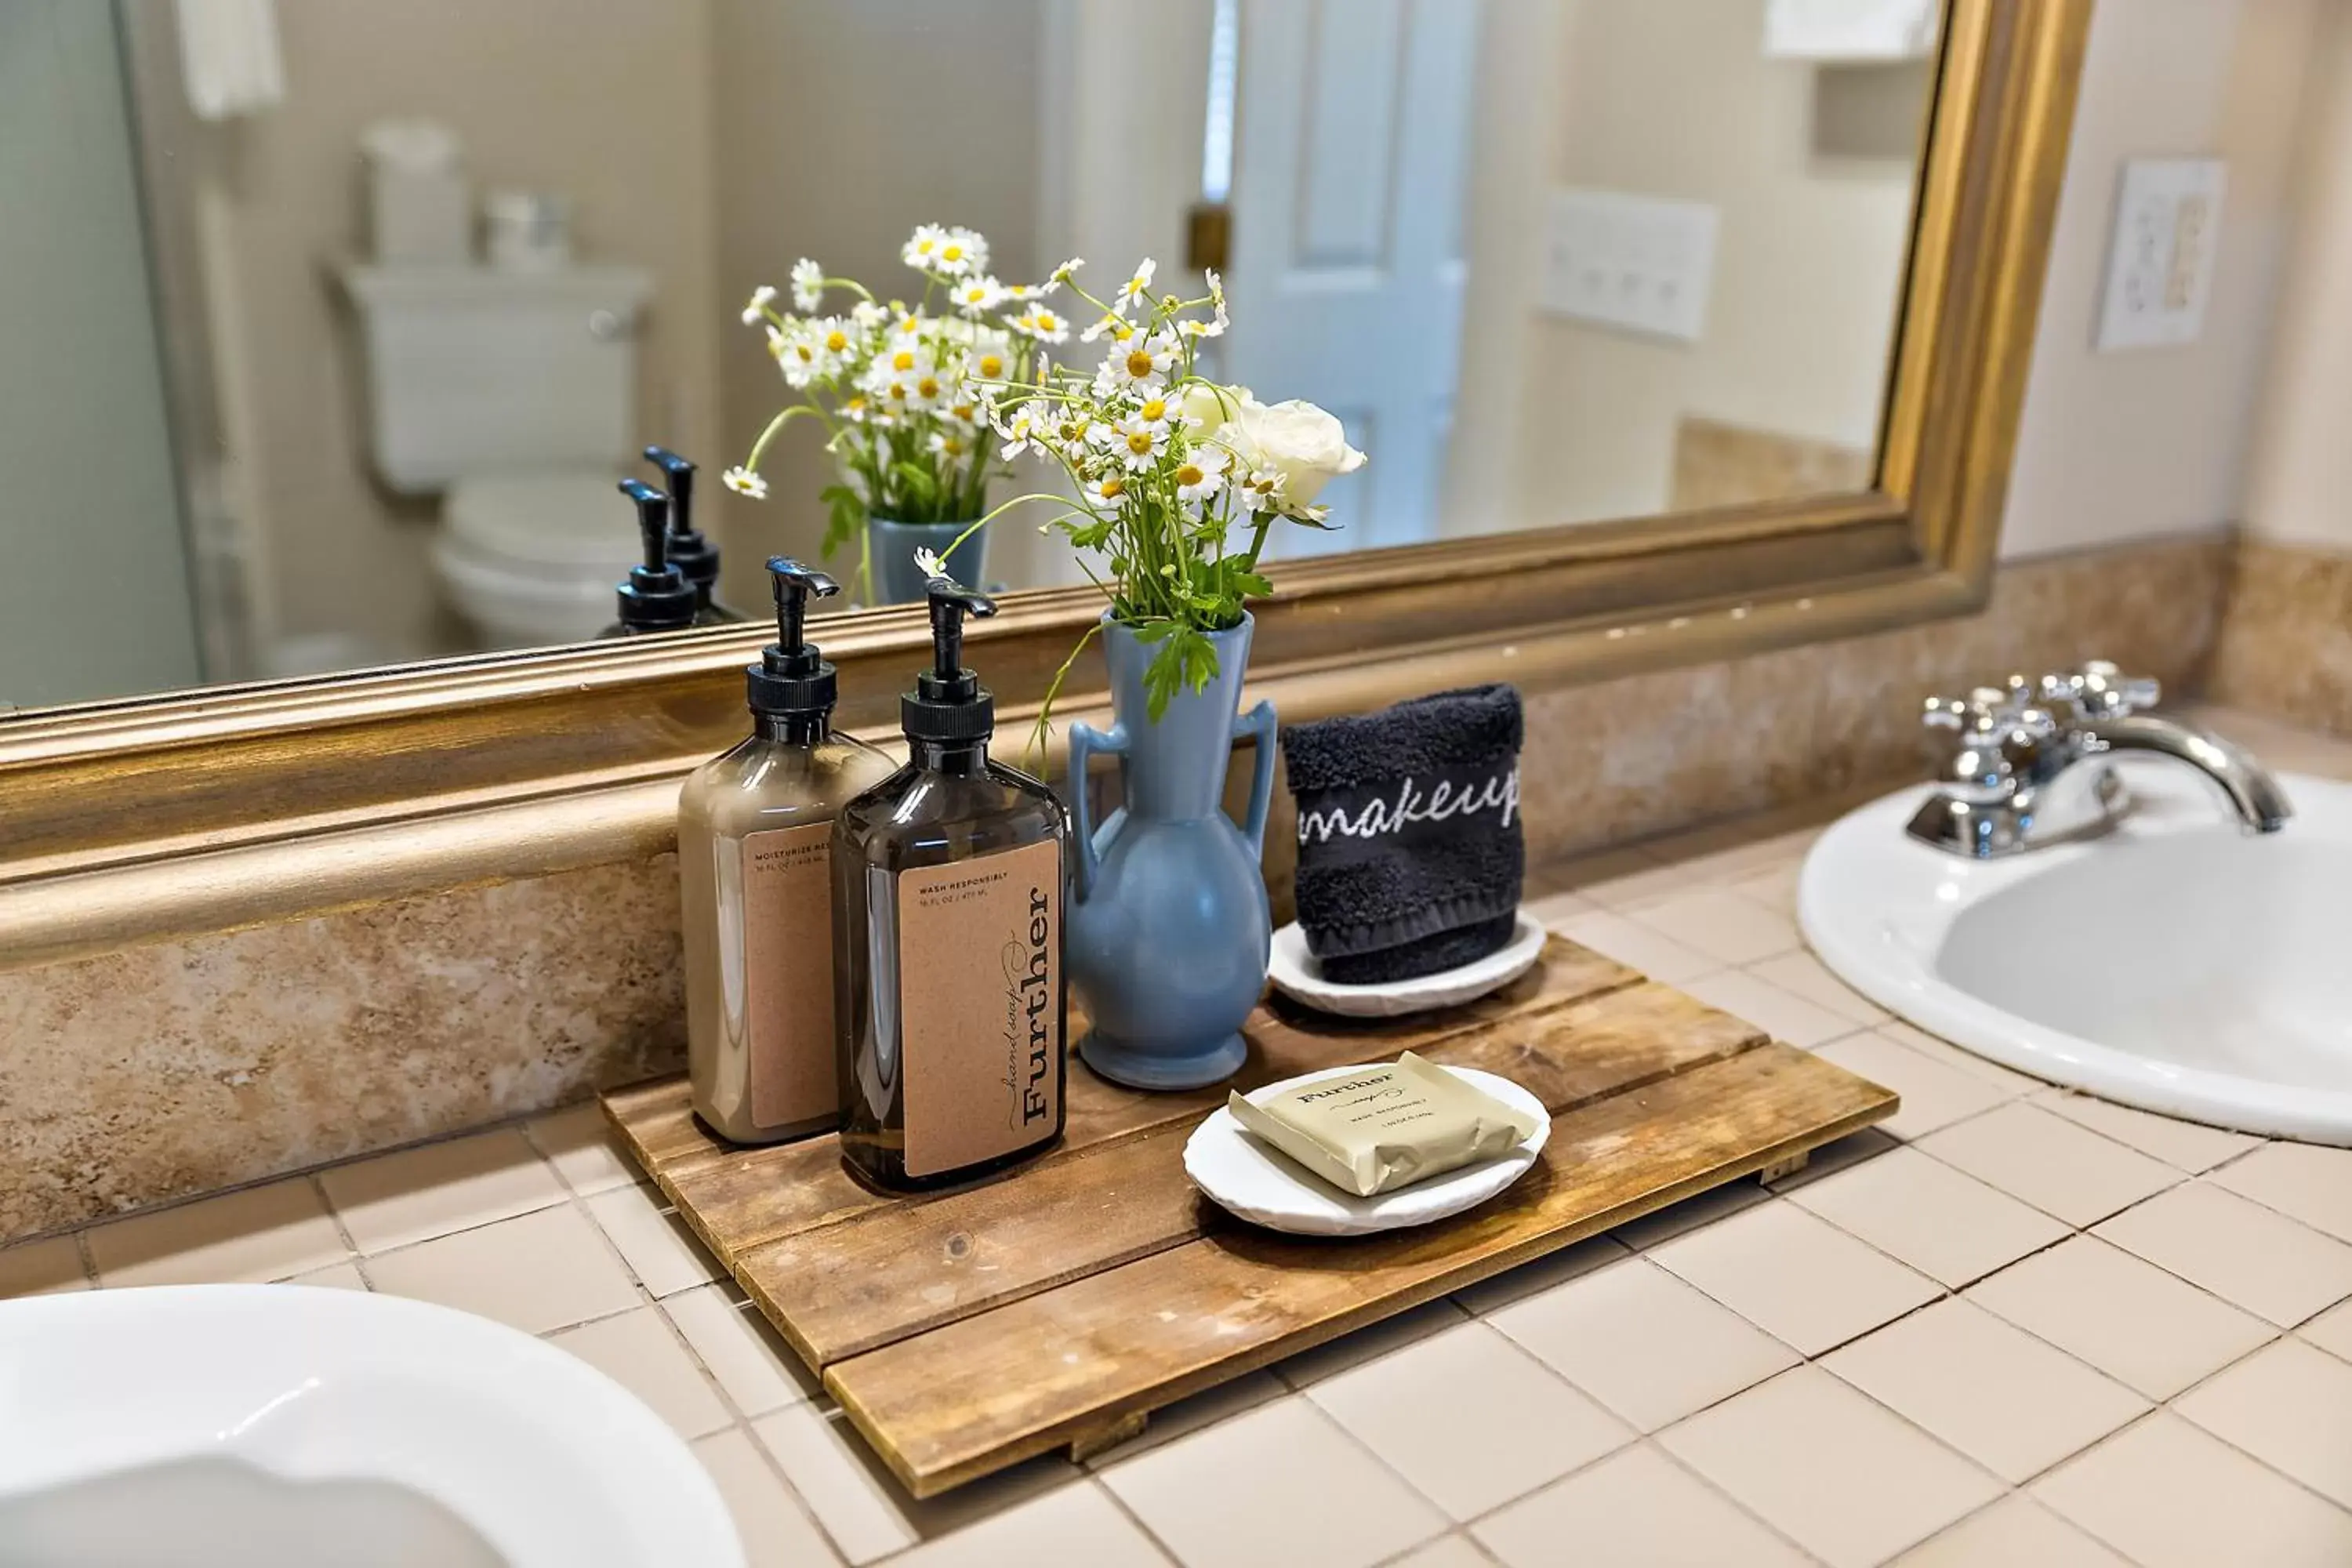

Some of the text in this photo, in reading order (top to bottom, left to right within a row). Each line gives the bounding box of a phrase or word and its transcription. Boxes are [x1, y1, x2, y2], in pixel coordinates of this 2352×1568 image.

[1298, 754, 1520, 846] makeup
[755, 845, 811, 860] MOISTURIZE
[919, 872, 1007, 895] WASH RESPONSIBLY
[1021, 887, 1048, 1127] Further
[1297, 1073, 1393, 1103] Further
